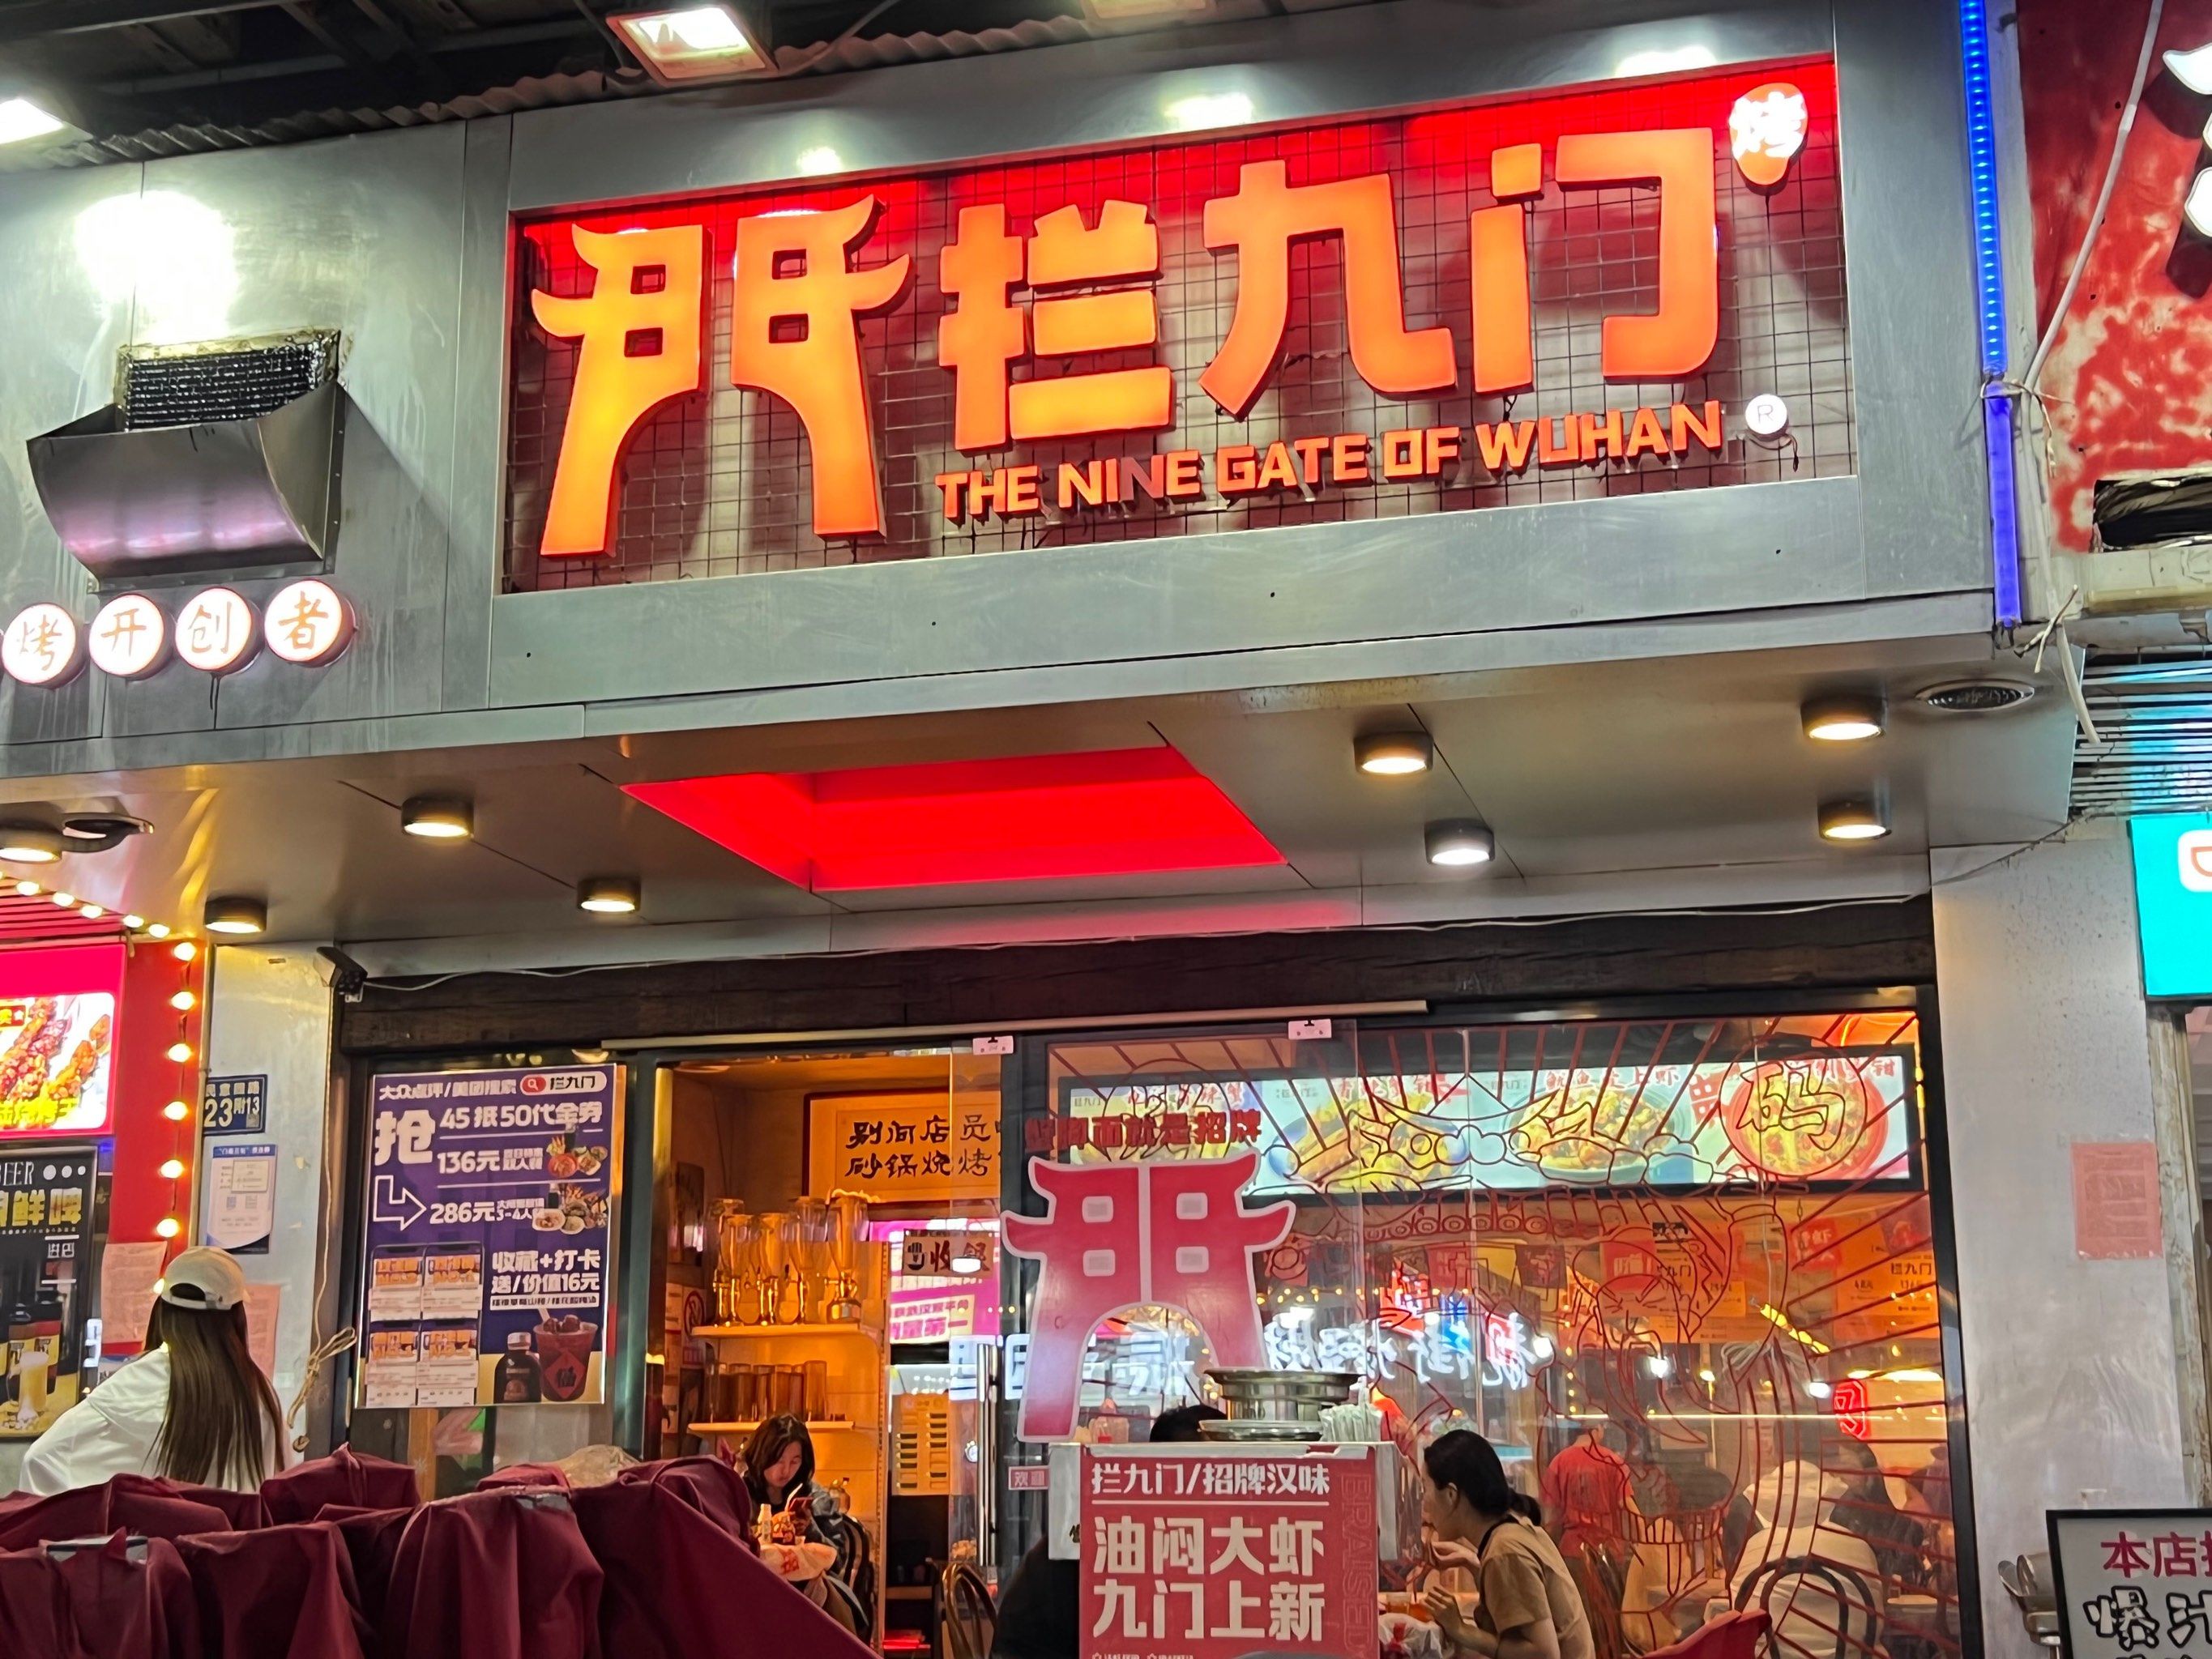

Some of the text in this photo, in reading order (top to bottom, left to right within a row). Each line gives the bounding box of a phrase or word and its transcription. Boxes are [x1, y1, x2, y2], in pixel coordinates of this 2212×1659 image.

[937, 127, 1719, 451] 拦九门
[935, 464, 1040, 519] THE
[1057, 449, 1202, 509] NINE
[1216, 433, 1369, 493] GATE
[1382, 426, 1460, 478] OF
[1475, 399, 1723, 471] WUHAN
[374, 1109, 436, 1166] 抢
[845, 1114, 1001, 1149] 别问店员
[0, 1161, 35, 1187] EER
[437, 1149, 501, 1174] 136元
[844, 1147, 1001, 1179] 砂锅烧烤
[429, 1201, 496, 1225] 286元
[1091, 1462, 1330, 1495] 拦九门/招牌汉味
[1092, 1578, 1326, 1642] 九门上新
